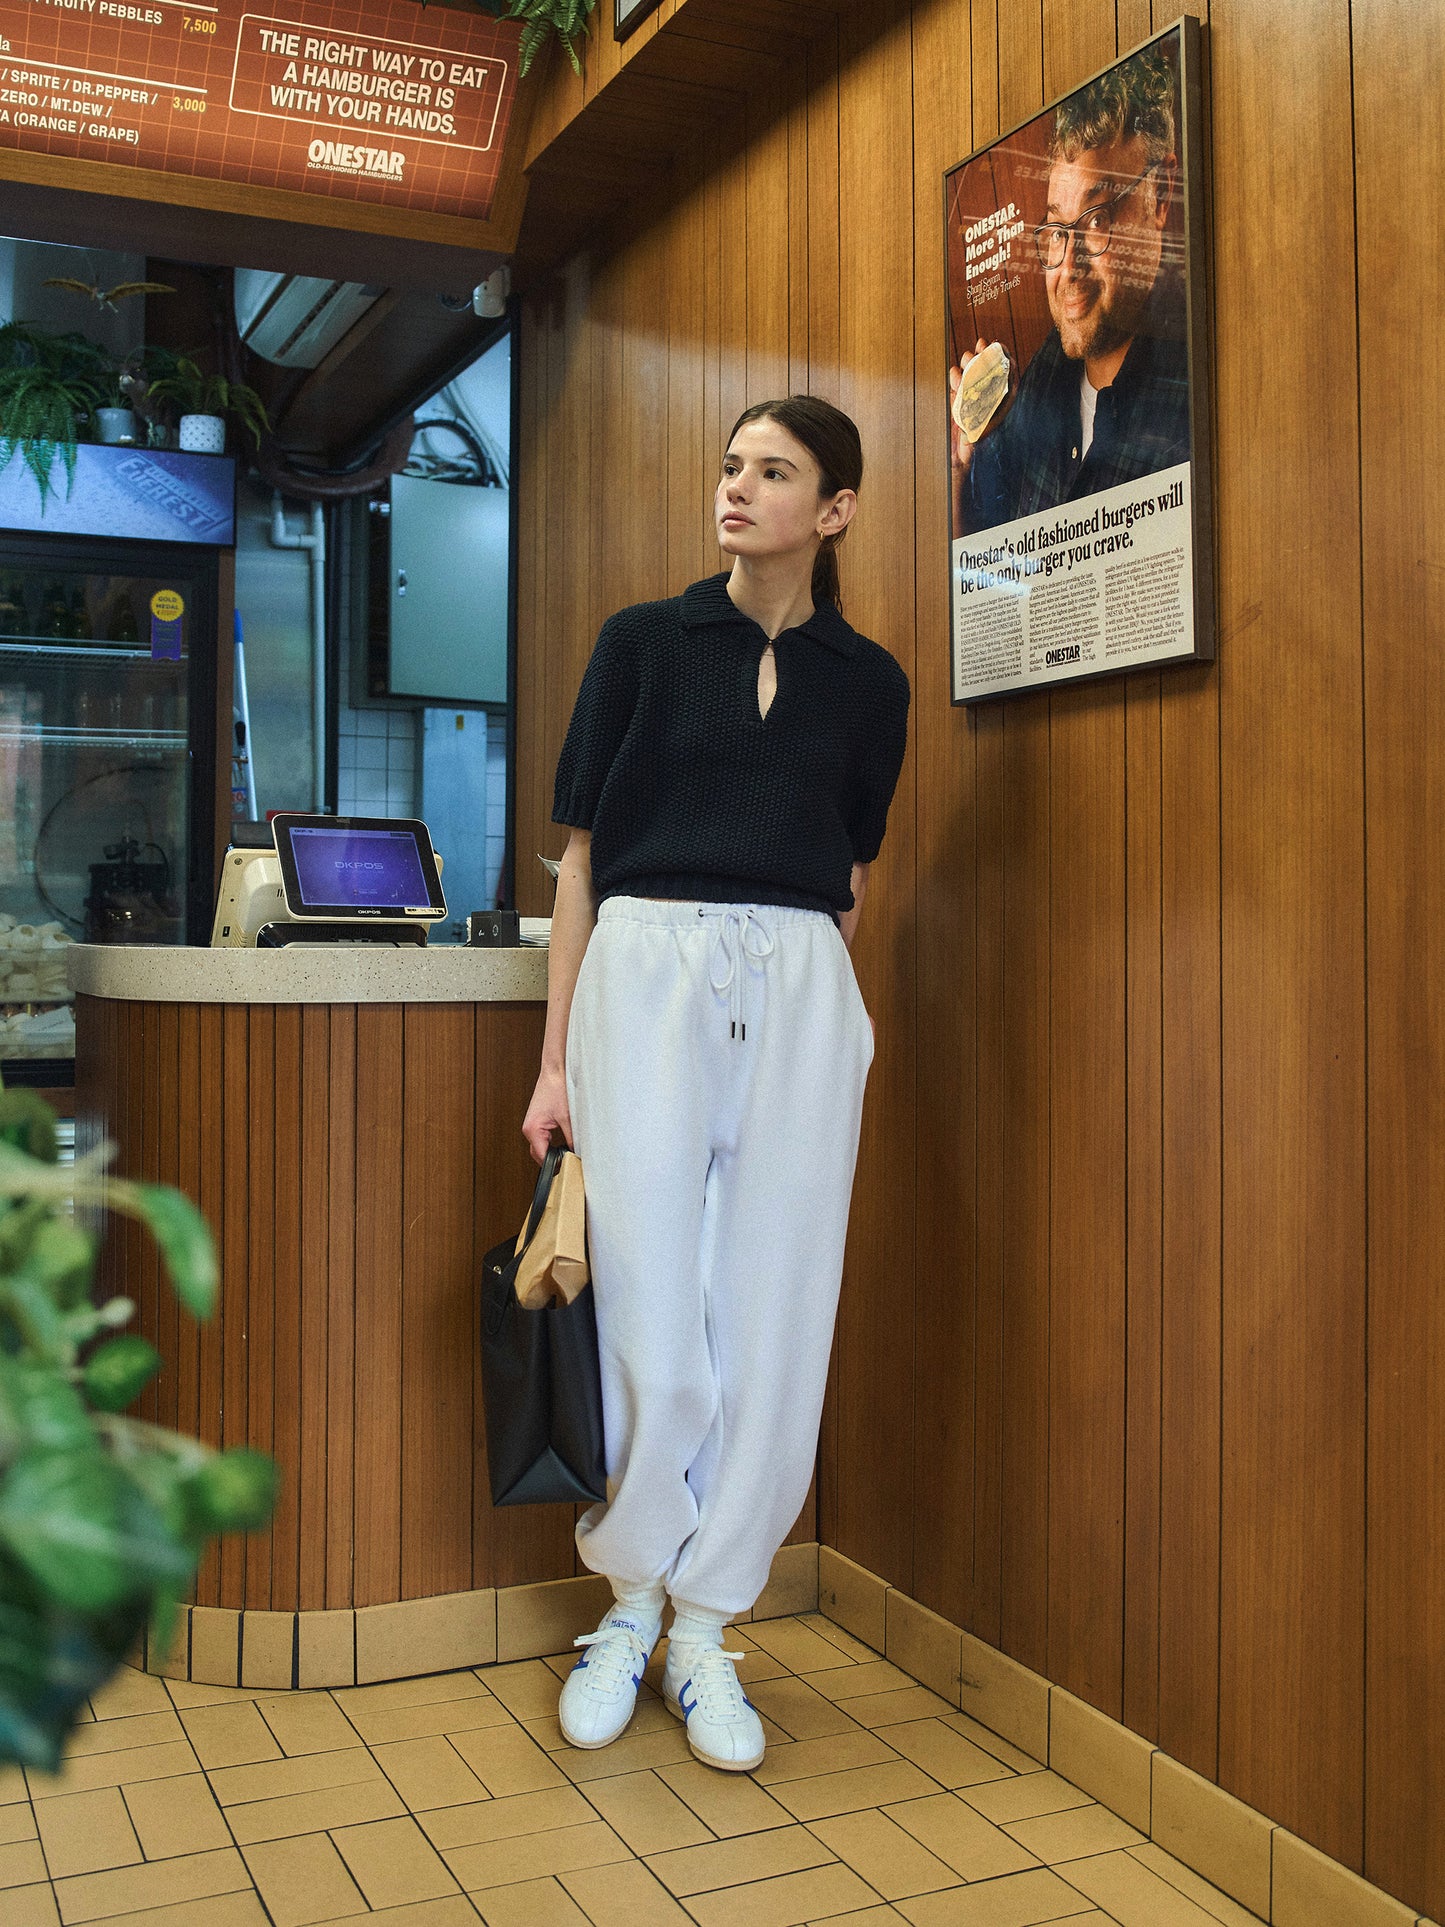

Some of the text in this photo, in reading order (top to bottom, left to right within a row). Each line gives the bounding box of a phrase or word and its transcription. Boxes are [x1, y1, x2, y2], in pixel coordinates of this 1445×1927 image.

[99, 2, 163, 24] PEBBLES
[183, 17, 217, 34] 7,500
[259, 29, 488, 88] THE RIGHT WAY TO EAT
[0, 89, 38, 106] ZERO
[51, 97, 103, 117] MT.DEW
[11, 70, 60, 89] SPRITE
[72, 79, 149, 104] DR.PEPPER
[282, 61, 455, 109] A HAMBURGER IS
[173, 96, 206, 112] 3,000
[270, 84, 457, 135] WITH YOUR HANDS.
[14, 111, 77, 133] (ORANGE
[88, 123, 139, 145] GRAPE)
[307, 161, 402, 181] OLD-FASHIONED HAMBURGERS
[308, 139, 405, 175] ONESTAR
[965, 203, 1020, 243] ONESTAR.
[965, 237, 995, 263] More
[996, 220, 1025, 245] Than
[965, 241, 1011, 281] Enough!
[960, 480, 1184, 573] Onestar's old fashioned burgers will
[960, 531, 1134, 595] be the only burger you crave.
[1045, 645, 1080, 664] ONESTAR
